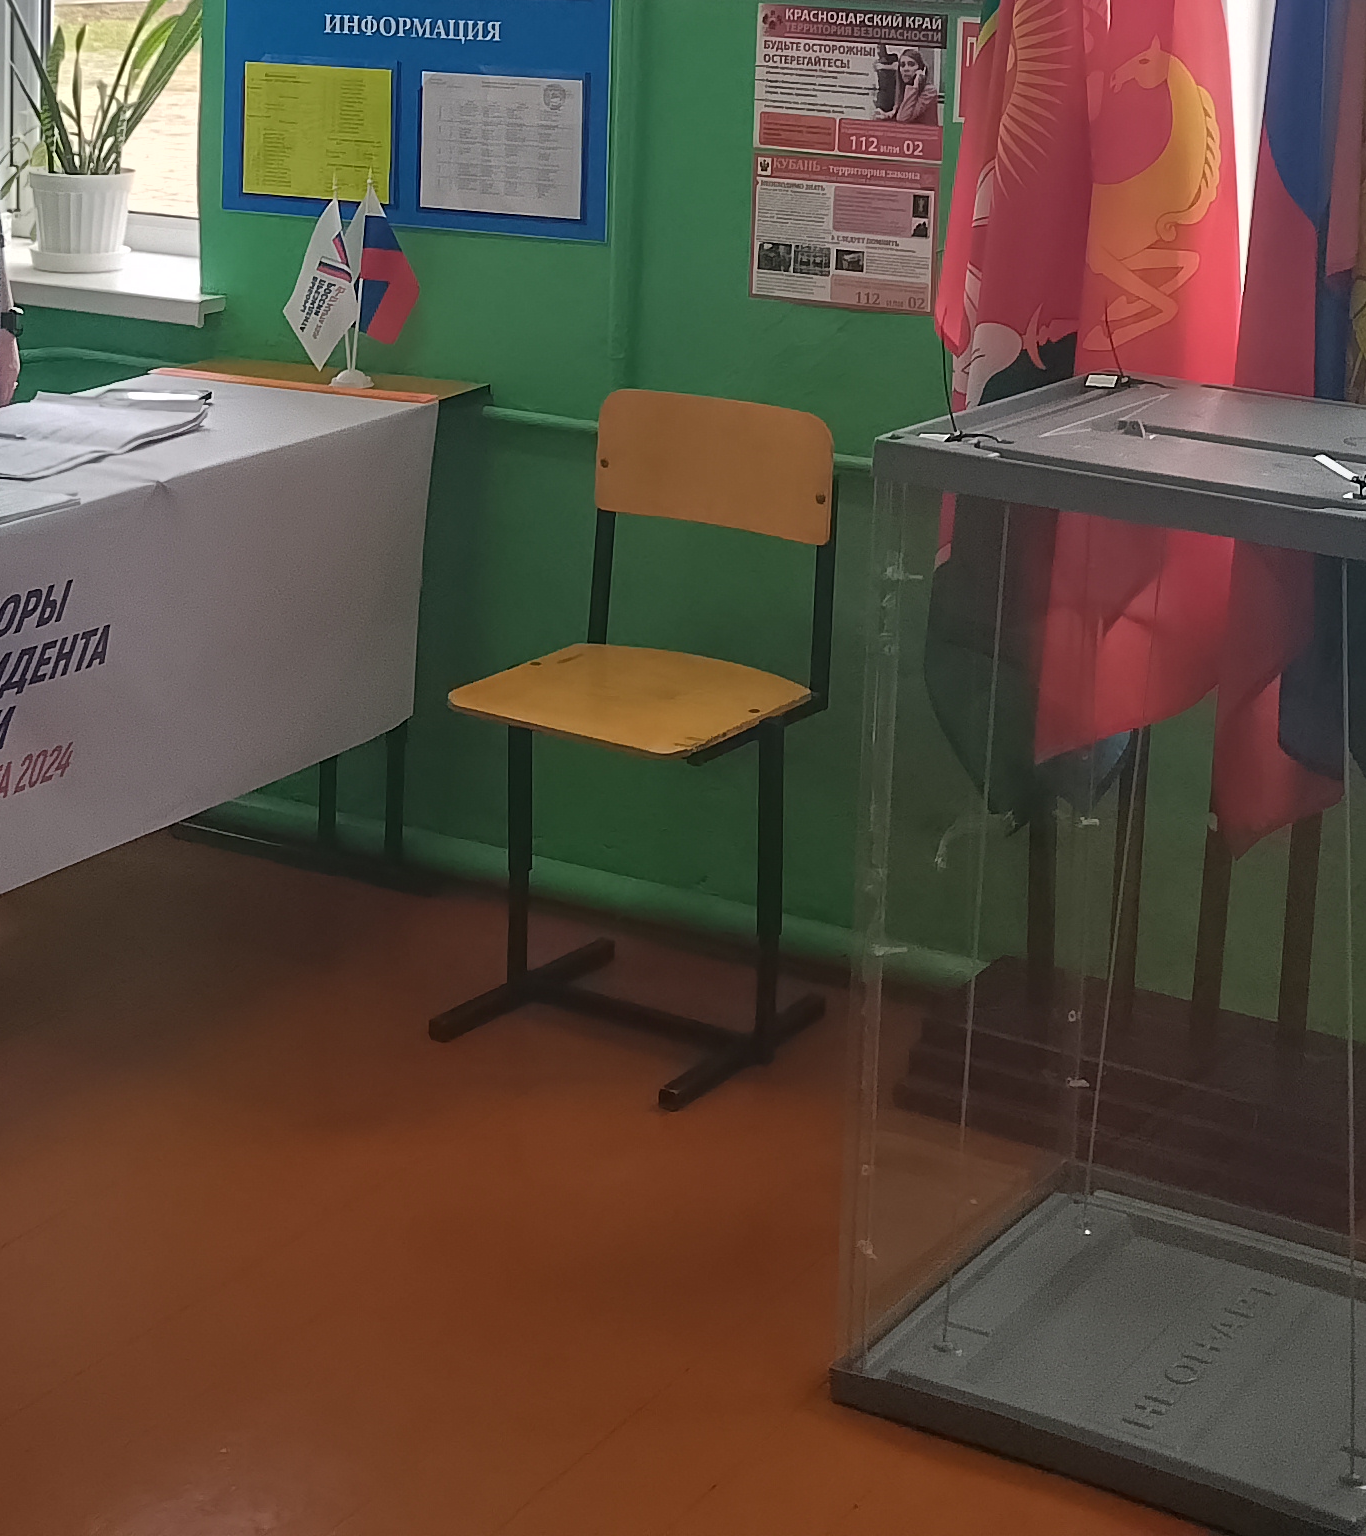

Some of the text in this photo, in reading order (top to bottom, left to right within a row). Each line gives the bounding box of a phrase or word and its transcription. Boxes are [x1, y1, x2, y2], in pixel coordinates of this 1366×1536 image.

[323, 13, 502, 43] ИНФОРМАЦИЯ
[785, 8, 942, 30] КРАСНОДАРСКИЙ КРАЙ
[785, 22, 942, 42] ТЕРРИТОРИЯ БЕЗОПАСНОСТИ
[763, 39, 802, 53] БУДЬТЕ
[763, 53, 851, 70] ОСТЕРЕГАЙТЕСЬ!
[849, 135, 924, 156] 112 или 02
[772, 157, 821, 172] КУБАНЬ
[828, 165, 885, 178] территория
[886, 170, 921, 180] закона
[855, 291, 880, 305] 112
[907, 296, 925, 310] 02
[13, 741, 74, 795] 2024
